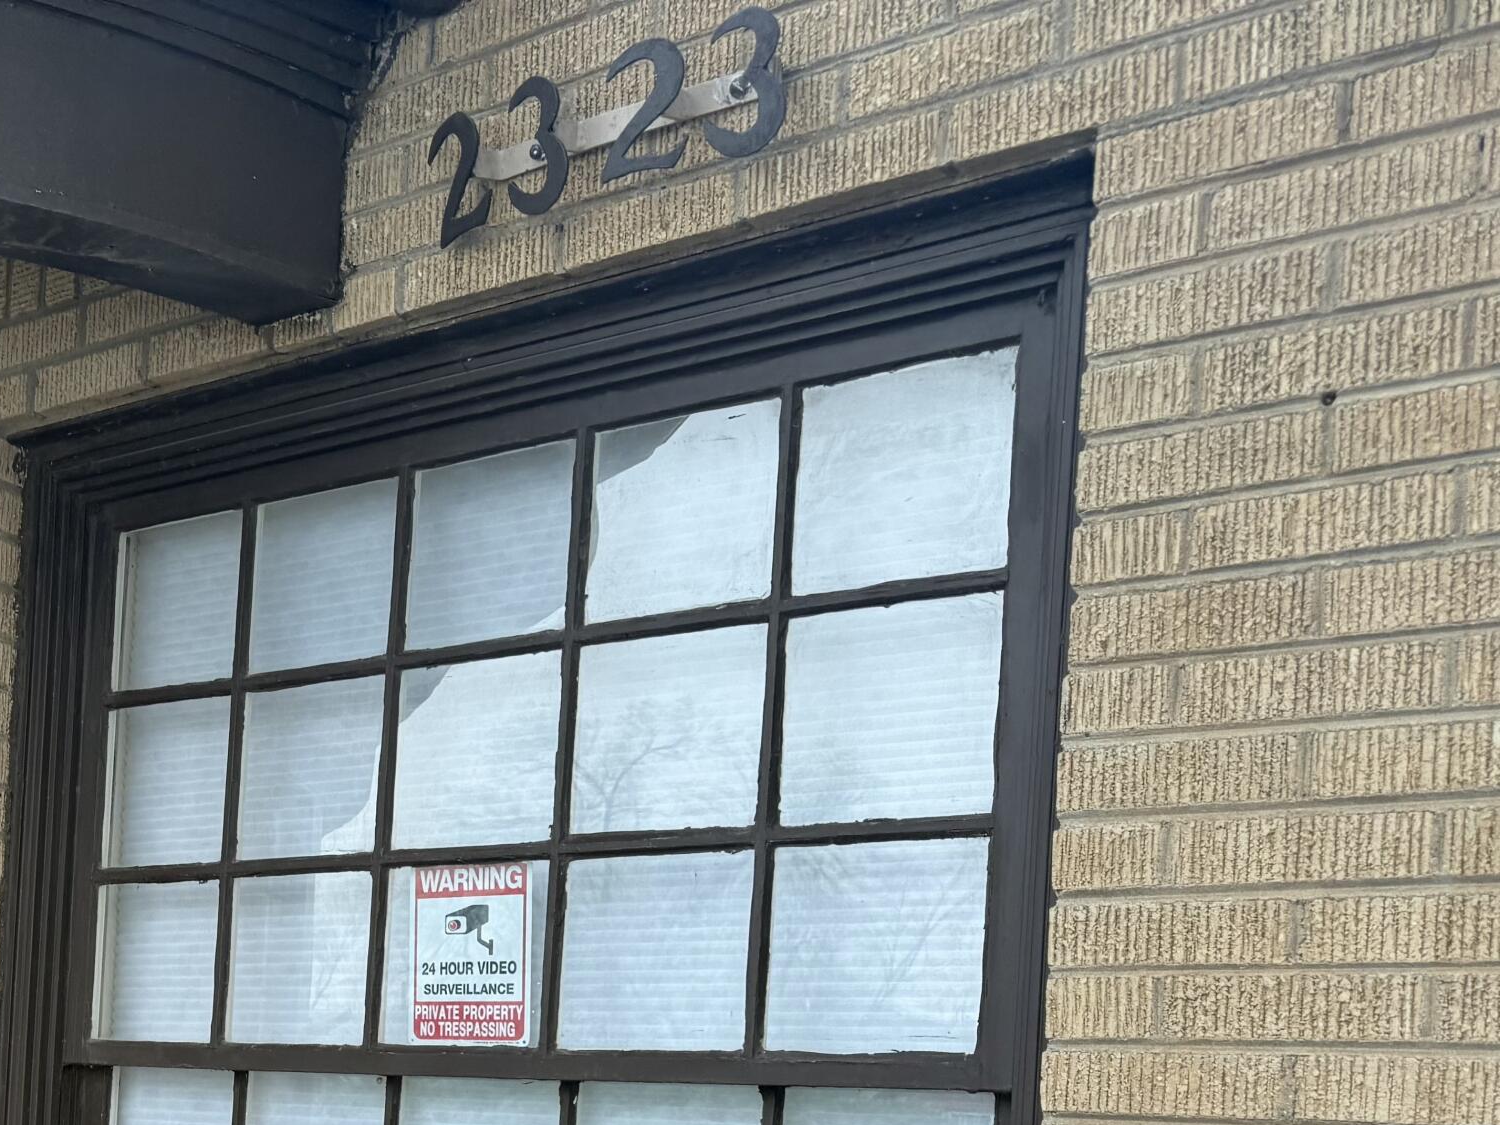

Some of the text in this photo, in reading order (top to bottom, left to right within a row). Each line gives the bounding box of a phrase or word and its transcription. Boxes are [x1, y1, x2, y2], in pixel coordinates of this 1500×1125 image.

[427, 6, 786, 249] 2323
[420, 865, 523, 893] WARNING
[421, 961, 517, 976] 24 HOUR VIDEO
[423, 983, 515, 995] SURVEILLANCE
[414, 1004, 524, 1021] PRIVATE PROPERTY
[419, 1022, 516, 1038] NO TRESPASSING
